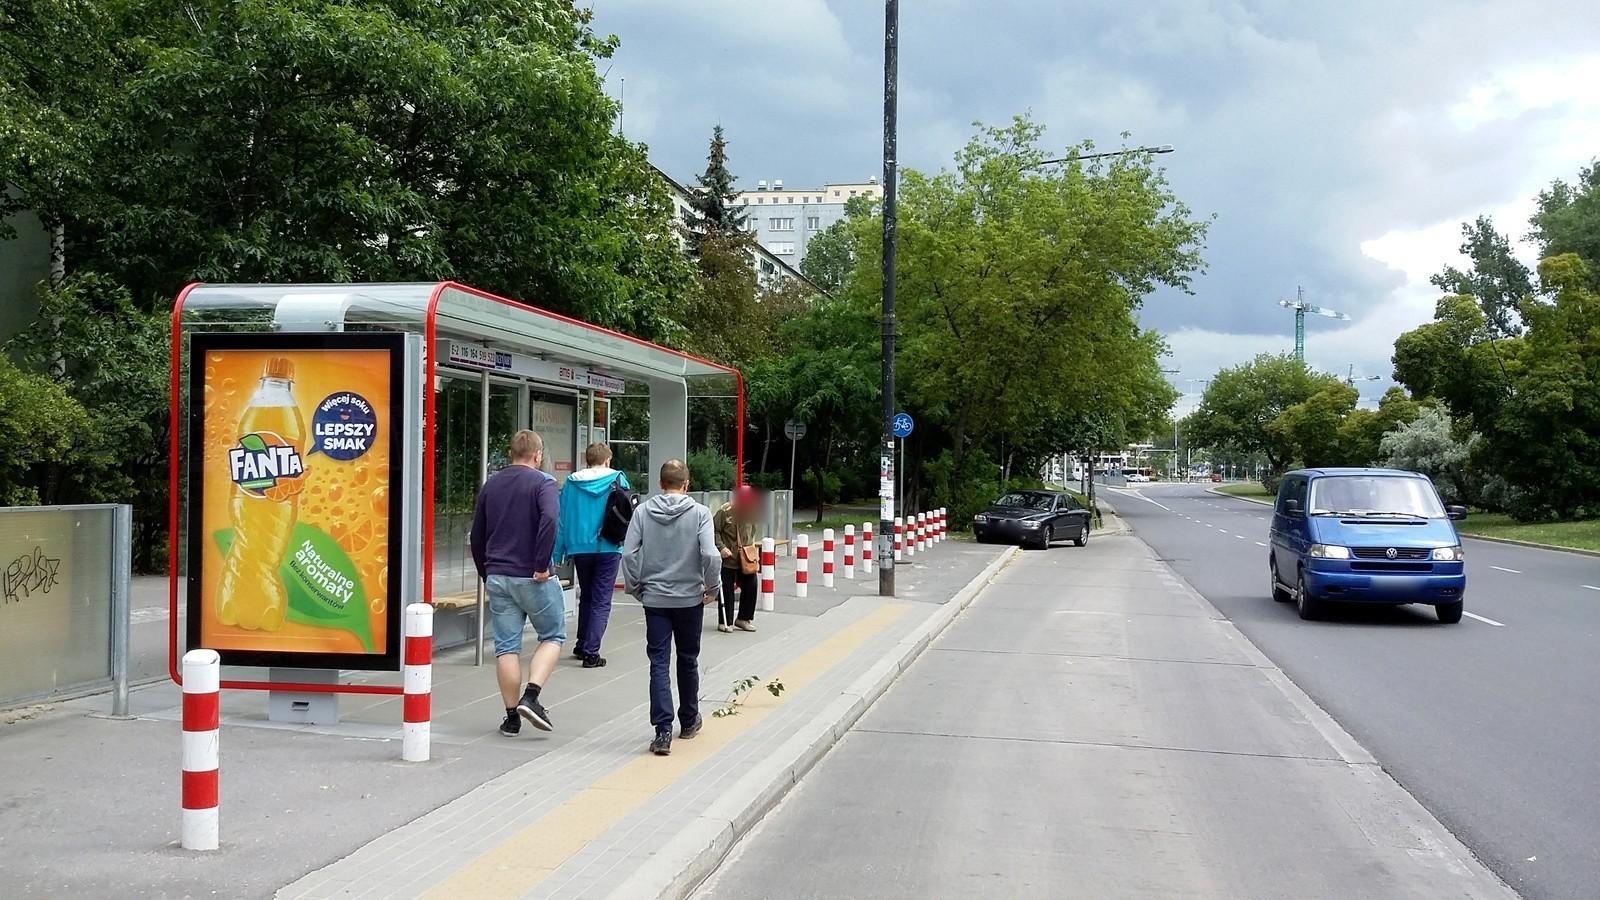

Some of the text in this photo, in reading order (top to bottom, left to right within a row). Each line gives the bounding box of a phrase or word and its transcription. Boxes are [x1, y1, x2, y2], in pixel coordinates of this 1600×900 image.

[321, 394, 370, 414] Więcej soku
[315, 422, 375, 436] LEPSZY
[323, 437, 366, 450] SMAK
[229, 446, 303, 481] FANTA
[295, 549, 354, 603] aromaty
[301, 539, 354, 589] Naturalne
